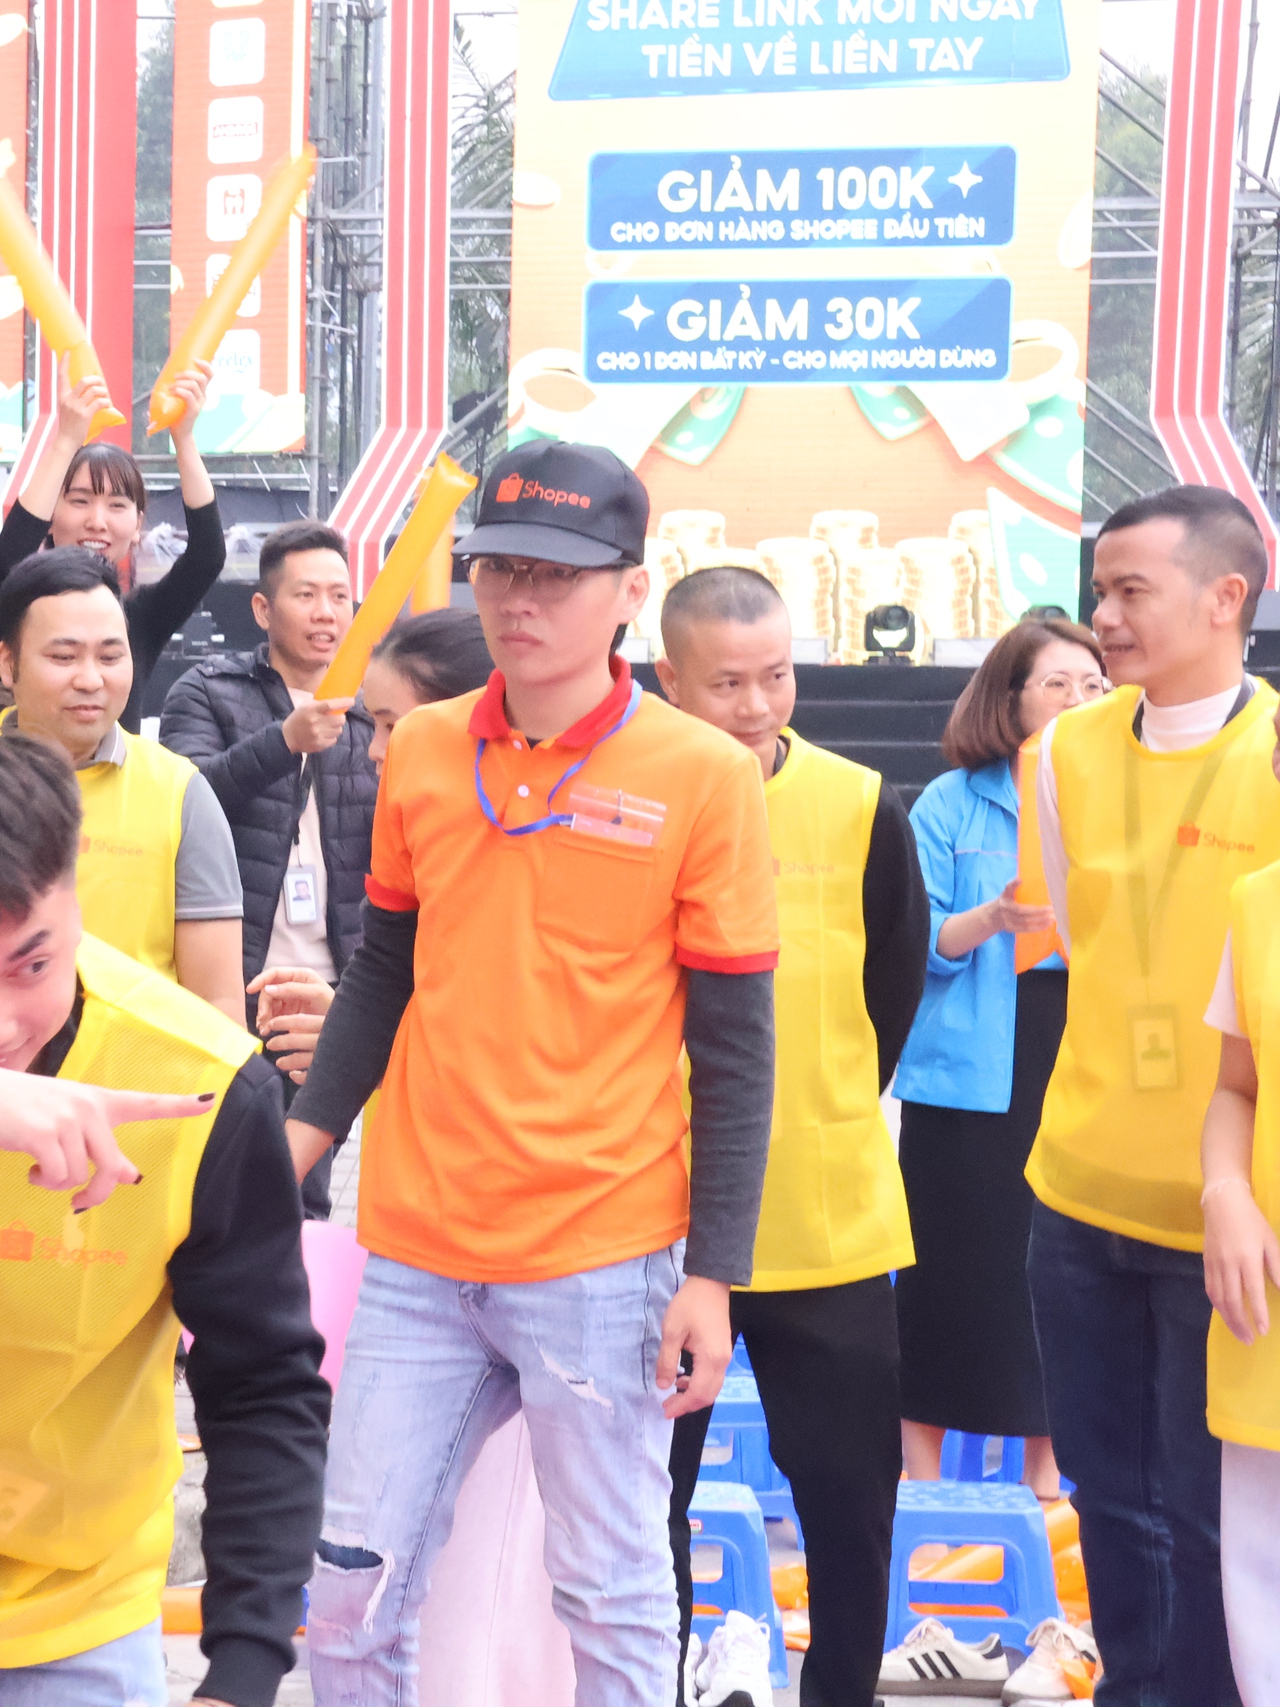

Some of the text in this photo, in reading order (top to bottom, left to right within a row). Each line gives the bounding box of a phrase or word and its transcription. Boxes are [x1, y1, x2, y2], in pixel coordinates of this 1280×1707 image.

[587, 0, 720, 31] SHARE
[733, 0, 824, 28] LINK
[641, 29, 984, 78] TIỀN VỀ LIỀN TAY
[657, 155, 935, 213] GIẢM 100K
[610, 220, 660, 243] CHO
[719, 216, 786, 242] HÀNG
[790, 218, 878, 241] SHOPEE
[934, 213, 985, 239] TIÊN
[666, 284, 921, 342] GIẢM 30K
[596, 350, 641, 371] CHO
[642, 351, 651, 371] 1
[699, 345, 737, 370] BẤT
[738, 346, 767, 370] KỲ
[782, 349, 827, 370] CHO
[829, 349, 869, 372] MỌI
[871, 345, 936, 370] NGƯỜI
[939, 345, 997, 369] DÙNG
[522, 480, 591, 509] Shopee
[93, 839, 143, 856] Shopee
[1204, 832, 1255, 854] Shopee
[783, 861, 834, 876] Shopee
